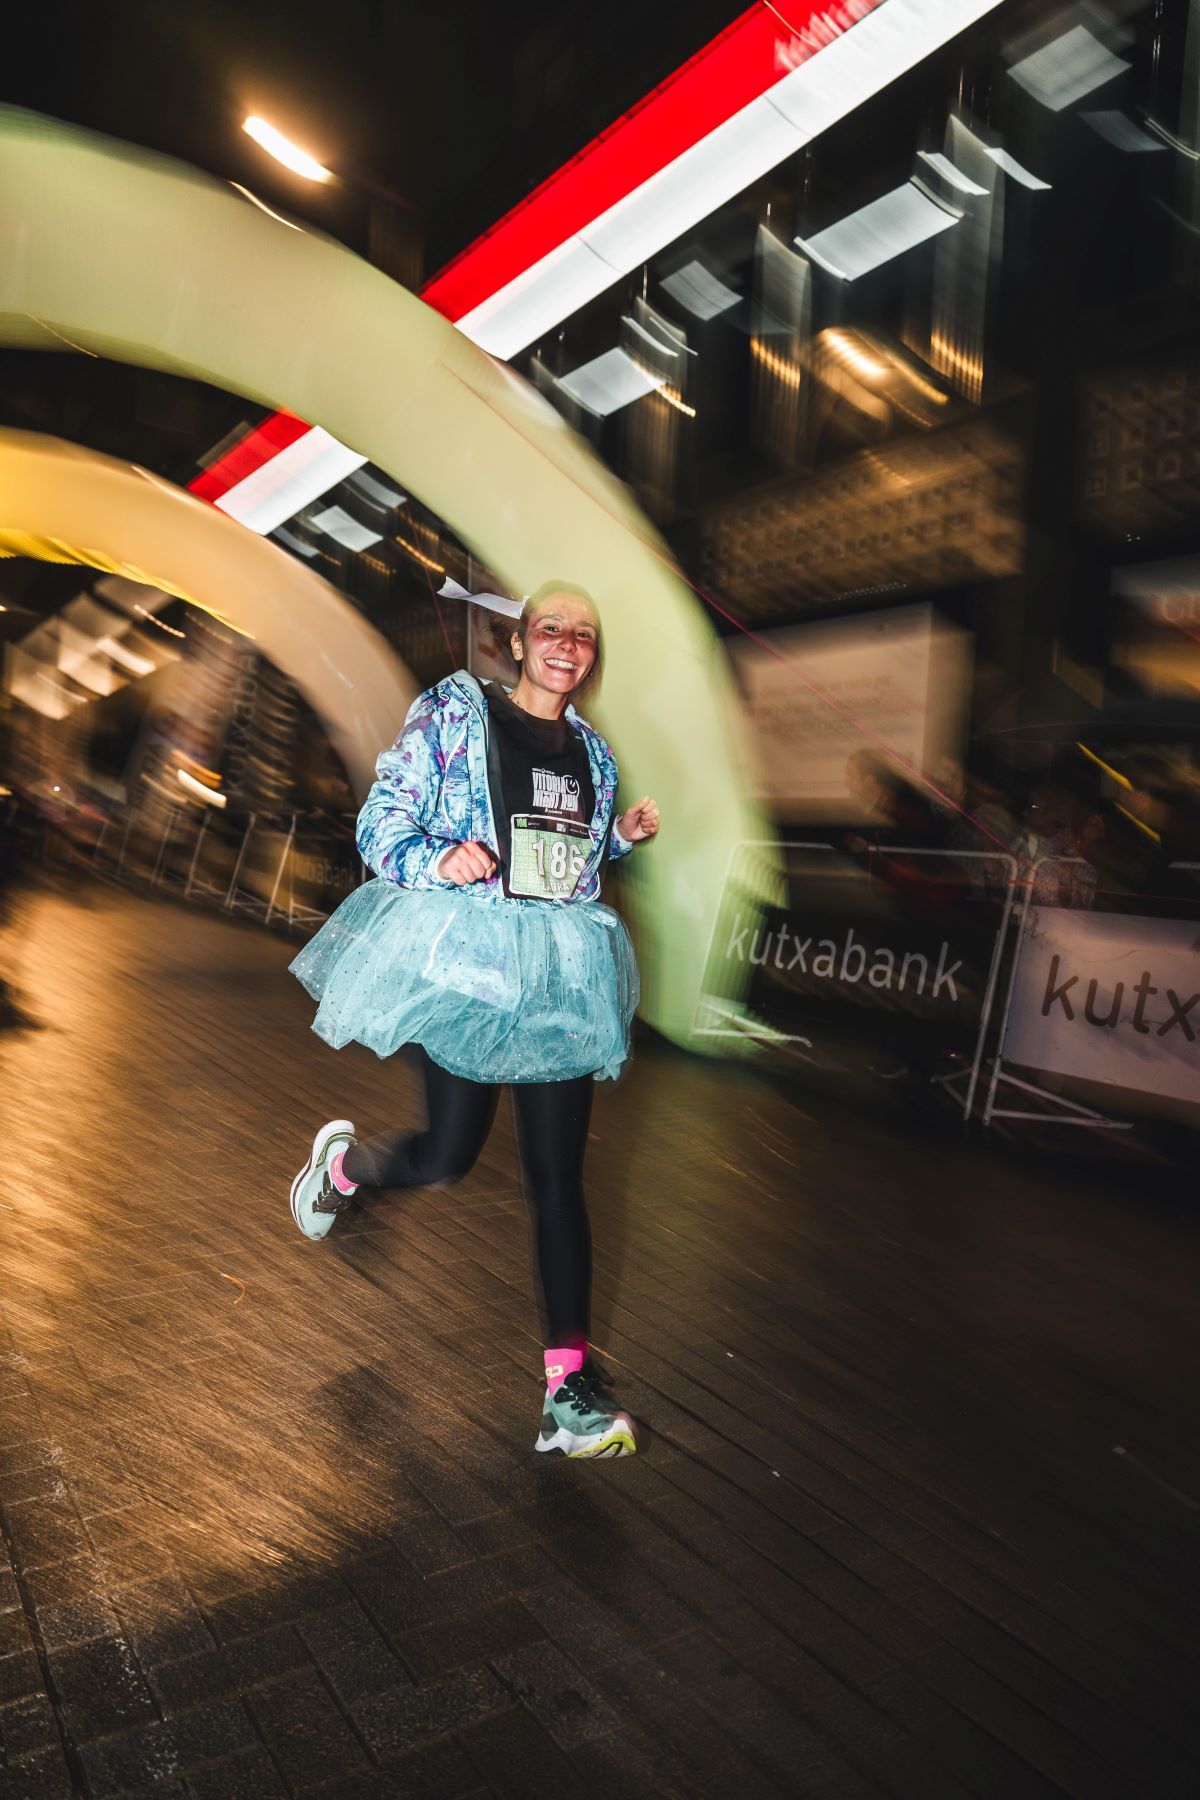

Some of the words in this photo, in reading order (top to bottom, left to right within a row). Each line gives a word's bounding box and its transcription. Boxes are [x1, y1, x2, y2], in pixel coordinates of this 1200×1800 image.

[532, 771, 566, 794] VITORIA
[532, 789, 560, 809] NIGHT
[560, 793, 579, 812] RUN
[532, 838, 586, 879] 186
[542, 881, 570, 892] LAURA
[725, 913, 963, 1003] kutxabank
[1041, 954, 1200, 1042] kutx
